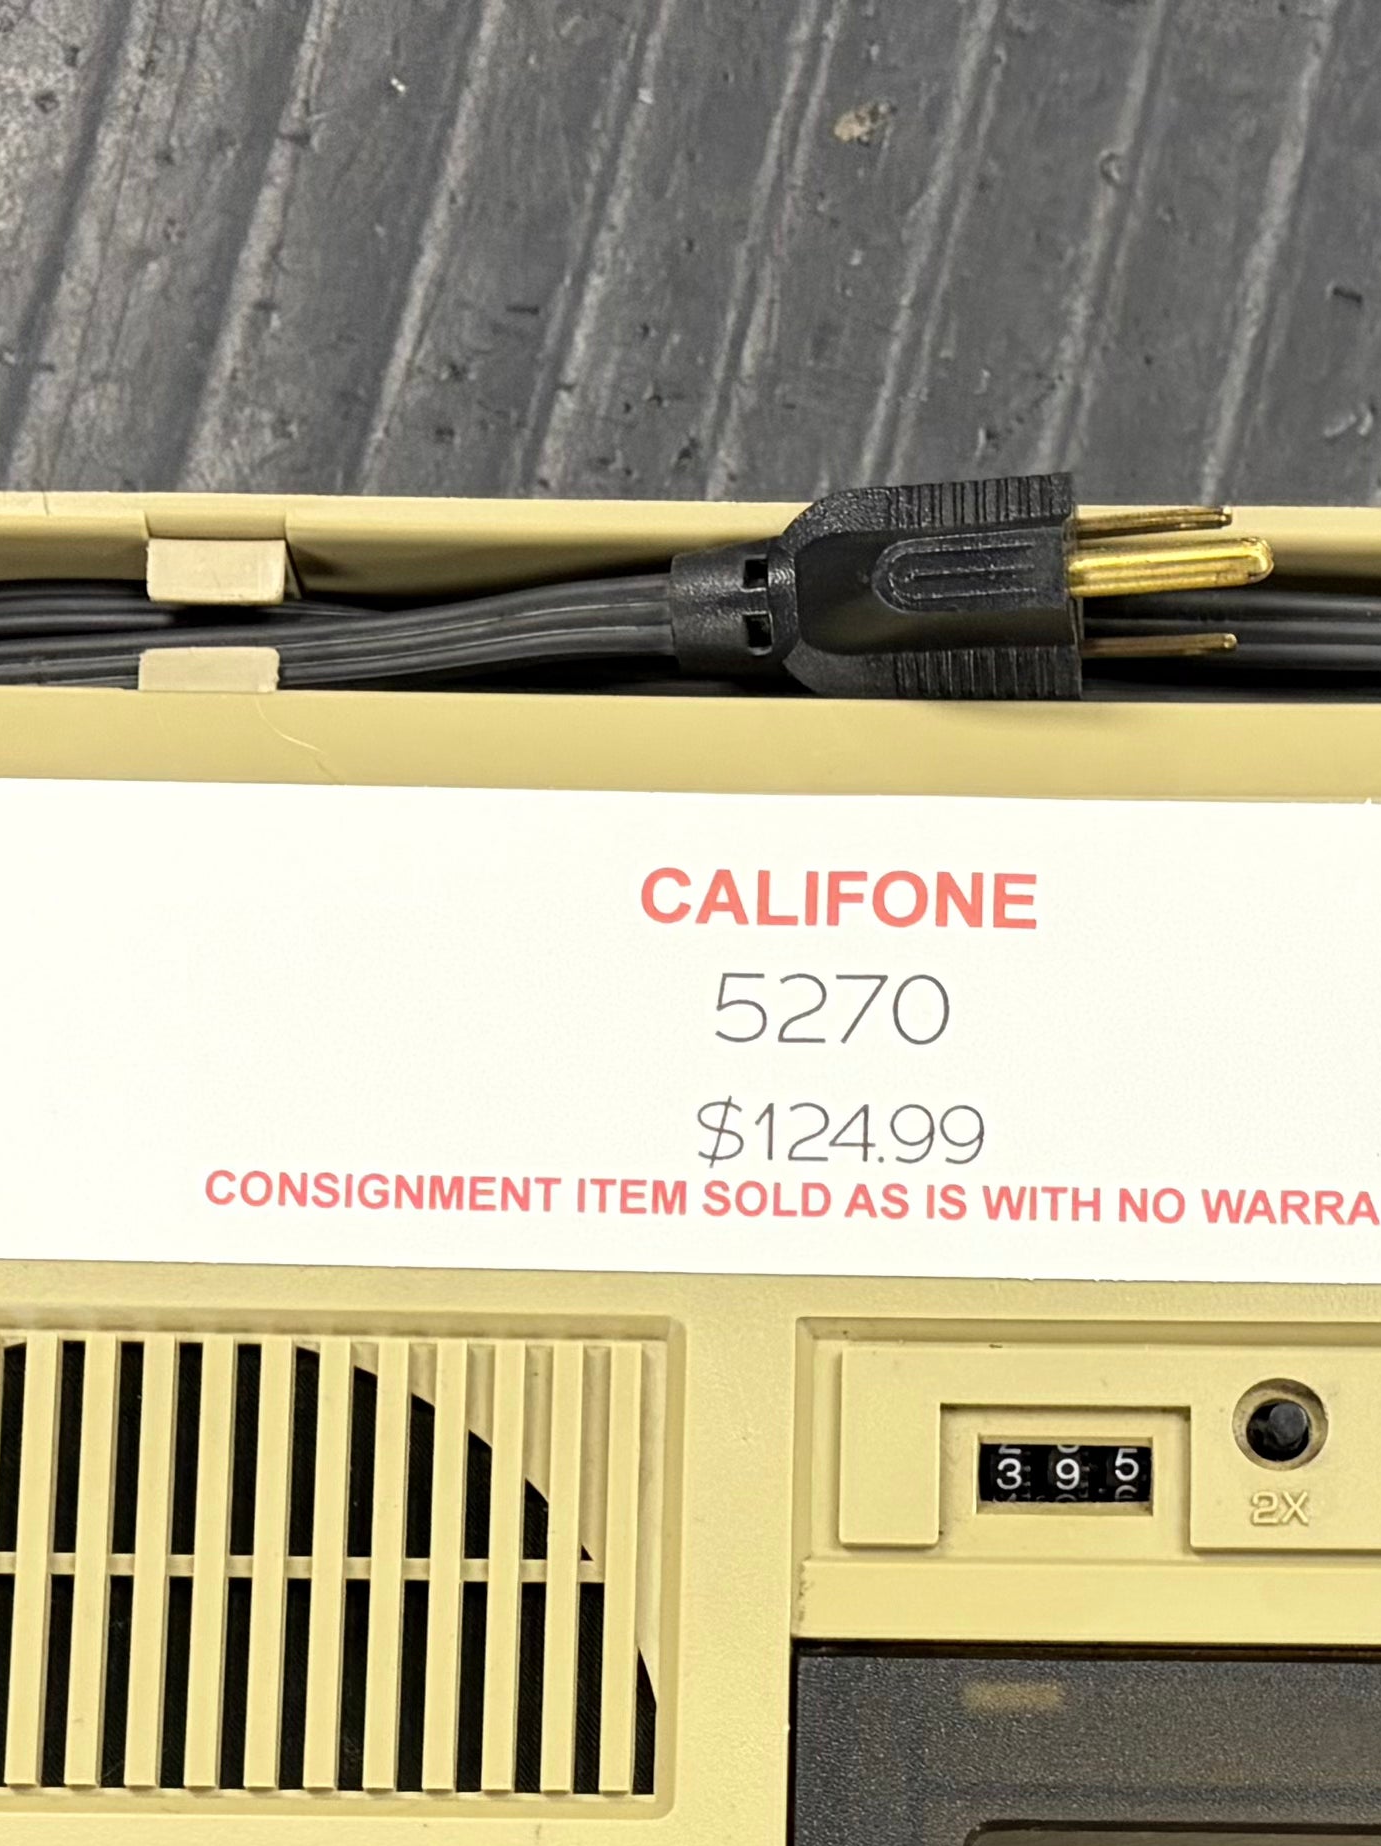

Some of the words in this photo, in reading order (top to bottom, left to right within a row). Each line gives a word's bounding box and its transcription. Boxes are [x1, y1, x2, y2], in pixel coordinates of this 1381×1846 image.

[641, 867, 1037, 930] CALIFONE
[715, 972, 950, 1045] 5270
[697, 1095, 985, 1169] $124.99
[206, 1171, 561, 1211] CONSIGNMENT
[578, 1179, 686, 1214] ITEM
[704, 1181, 831, 1217] SOLD
[846, 1184, 909, 1219] AS
[928, 1185, 966, 1220] IS
[984, 1187, 1100, 1221] WITH
[1120, 1188, 1185, 1223] NO
[1250, 1490, 1309, 1525] 2X
